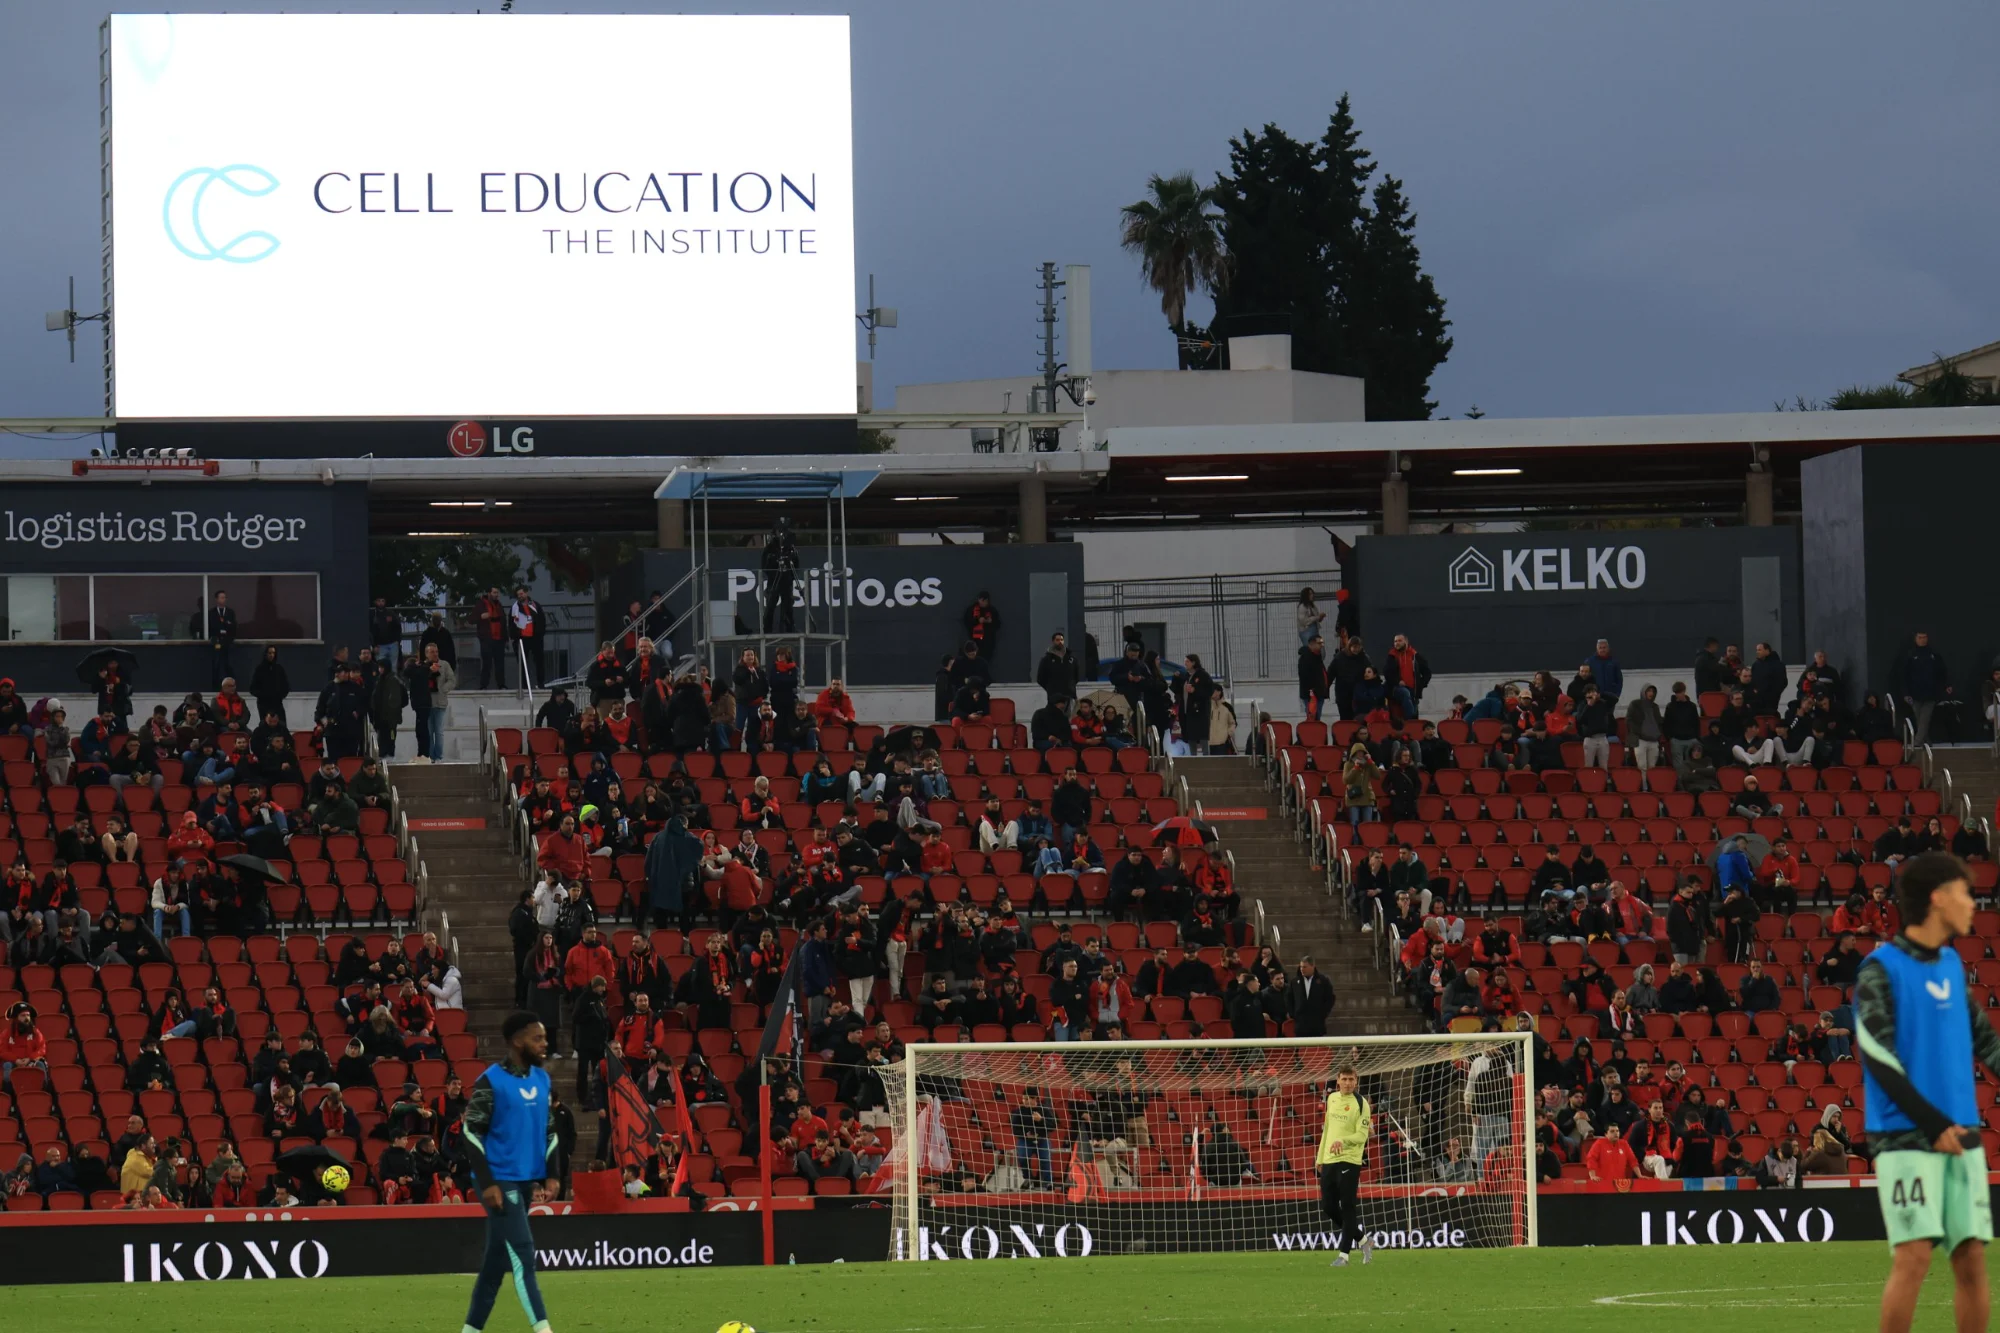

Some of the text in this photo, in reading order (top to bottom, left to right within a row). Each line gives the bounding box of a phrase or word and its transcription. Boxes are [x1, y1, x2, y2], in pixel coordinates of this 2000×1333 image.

[313, 171, 817, 214] CELL EDUCATION
[542, 229, 817, 254] THE INSTITUTE
[493, 426, 534, 453] LG
[5, 510, 306, 549] logistics Rotger
[1502, 545, 1646, 592] KELKO
[1892, 1176, 1926, 1208] 44
[896, 1222, 1093, 1261] IKONO
[1641, 1207, 1834, 1246] IKONO
[123, 1239, 329, 1282] IKONO
[534, 1238, 714, 1267] ww.ikono.de
